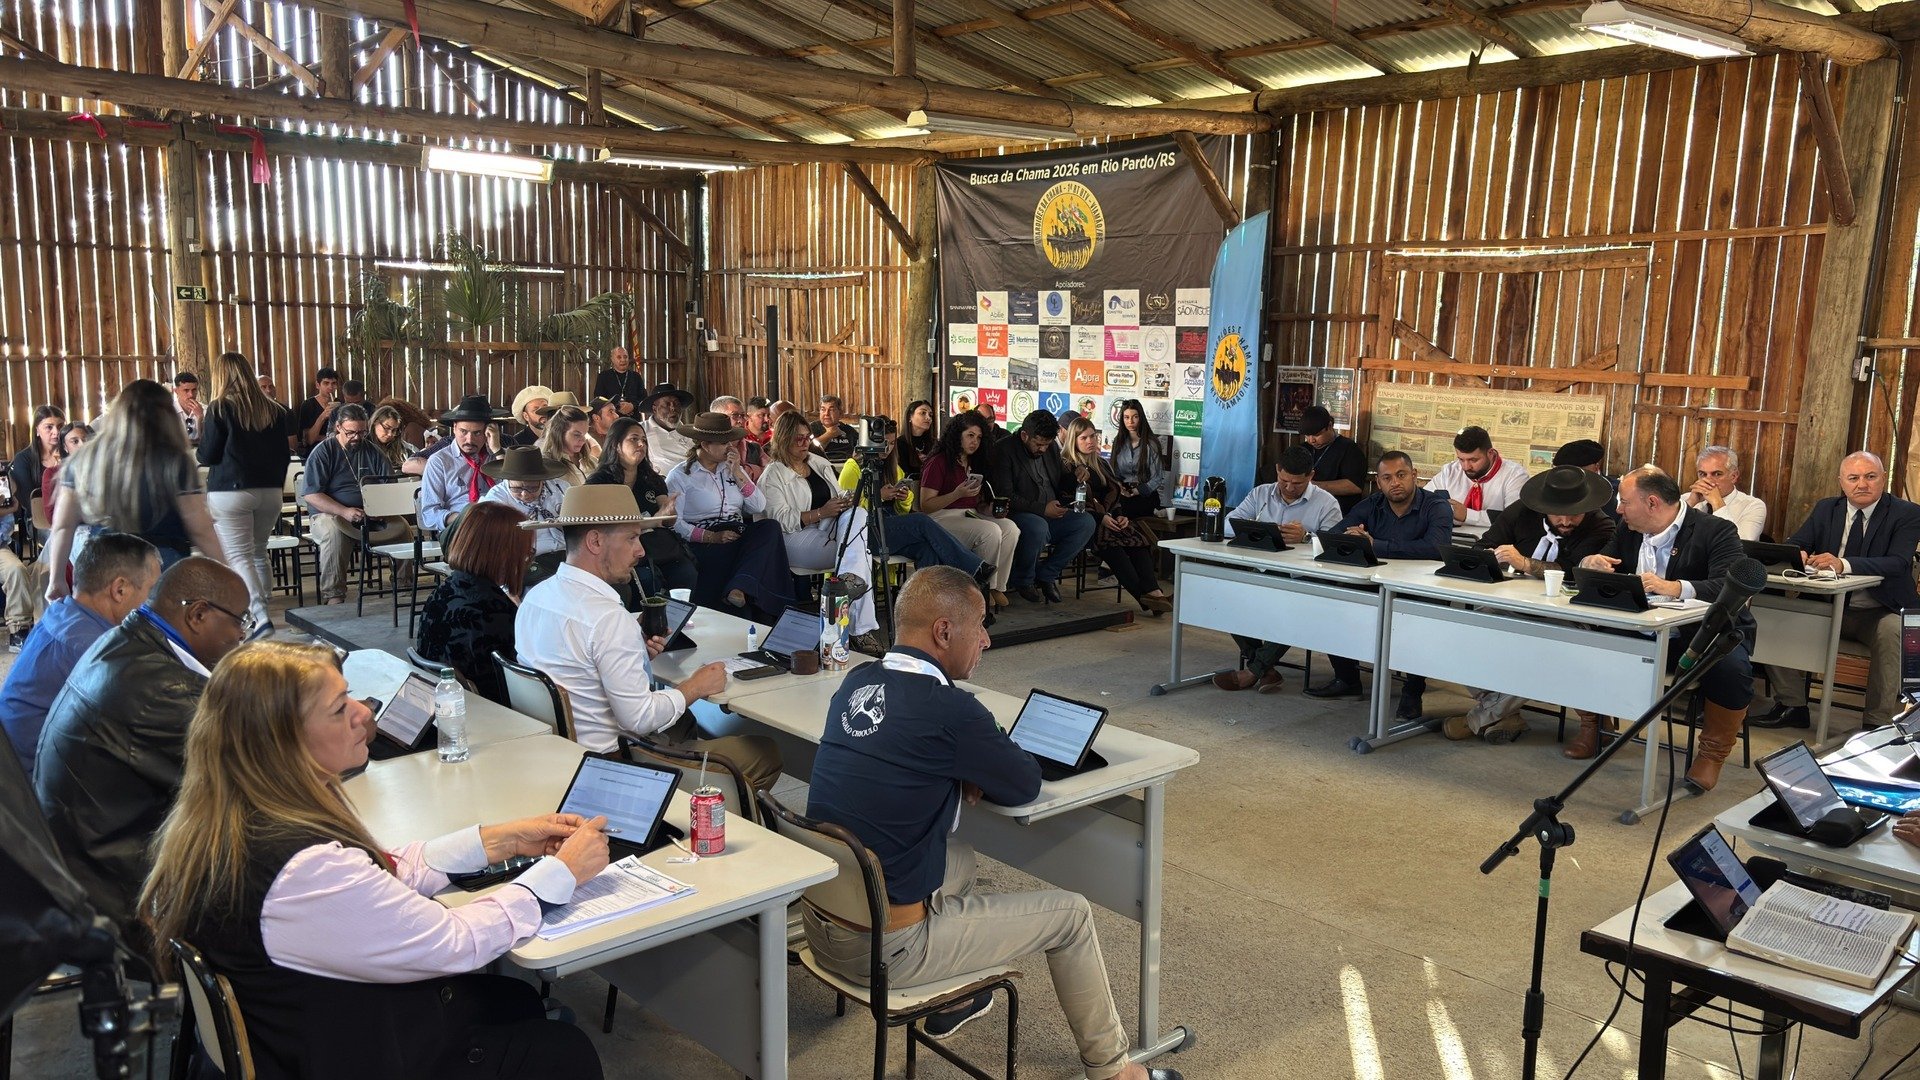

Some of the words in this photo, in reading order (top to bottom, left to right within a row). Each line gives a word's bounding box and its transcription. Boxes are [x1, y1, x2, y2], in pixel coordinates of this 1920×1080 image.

[970, 173, 999, 186] Busca
[1001, 170, 1014, 183] da
[1016, 168, 1051, 181] Chama
[1052, 163, 1080, 178] 2026
[1082, 163, 1099, 175] em
[1101, 159, 1119, 173] Rio
[1121, 152, 1176, 171] Pardo/RS
[1046, 186, 1063, 202] CHAMA
[1055, 281, 1086, 289] Apoiadores:
[1042, 370, 1057, 378] Rotary
[1182, 452, 1200, 460] CRES
[841, 711, 853, 734] CAVALO
[851, 724, 879, 737] CRIOULO
